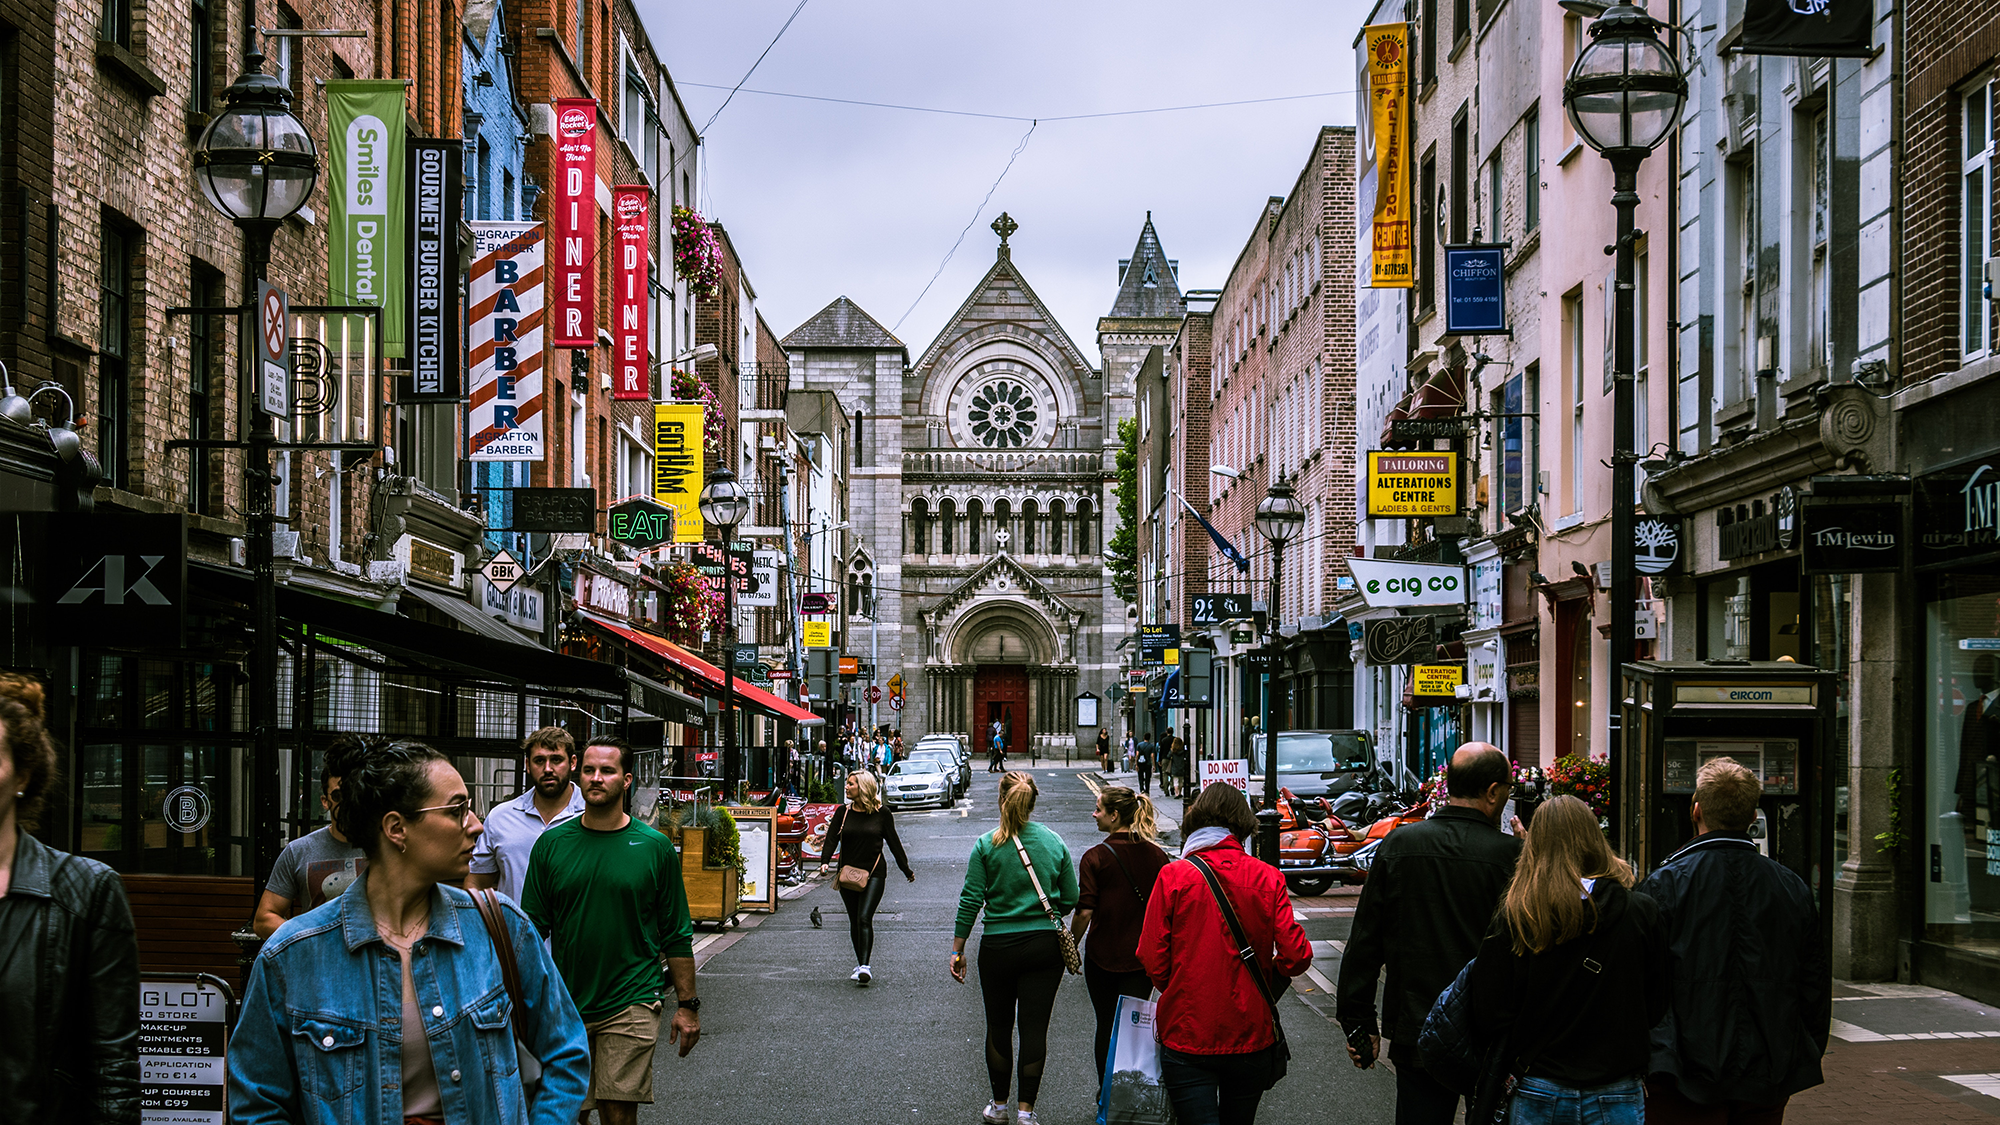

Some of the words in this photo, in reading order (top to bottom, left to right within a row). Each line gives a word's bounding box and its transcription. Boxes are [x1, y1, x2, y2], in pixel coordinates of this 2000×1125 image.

[1386, 98, 1398, 217] ALTERATION
[357, 129, 379, 206] Smiles
[420, 149, 440, 236] GOURMET
[476, 230, 486, 252] THE
[486, 230, 540, 240] GRAFTON
[1376, 224, 1408, 248] CENTRE
[488, 244, 534, 253] BARBER
[565, 168, 583, 337] DINER
[356, 221, 378, 300] Dental
[420, 240, 438, 310] BURGER
[1453, 268, 1497, 278] CHIFFON
[623, 245, 638, 390] DINER
[493, 260, 521, 429] BARBER
[419, 316, 438, 393] KITCHEN
[476, 432, 484, 454] THE
[484, 432, 538, 442] GRAFTON
[486, 446, 533, 454] BARBER
[657, 422, 697, 494] GOTHAM
[1383, 460, 1444, 470] TAILORING
[1377, 478, 1452, 489] ALTERATIONS
[521, 496, 589, 508] GRAFTON
[1392, 491, 1435, 502] CENTRE
[526, 512, 584, 523] BARBER
[613, 510, 668, 540] EAT
[728, 542, 751, 552] INES
[491, 566, 514, 578] GBK
[698, 566, 725, 575] SPIRITS
[1367, 579, 1380, 594] e
[1428, 576, 1458, 591] co
[513, 590, 517, 616] @
[529, 595, 537, 620] SIX
[1194, 599, 1218, 622] 22
[1208, 763, 1220, 774] DO
[1222, 762, 1239, 774] NOT
[1227, 778, 1247, 789] THIS
[179, 796, 197, 823] B
[312, 862, 352, 871] MUSIC
[144, 991, 216, 1007] GLOT
